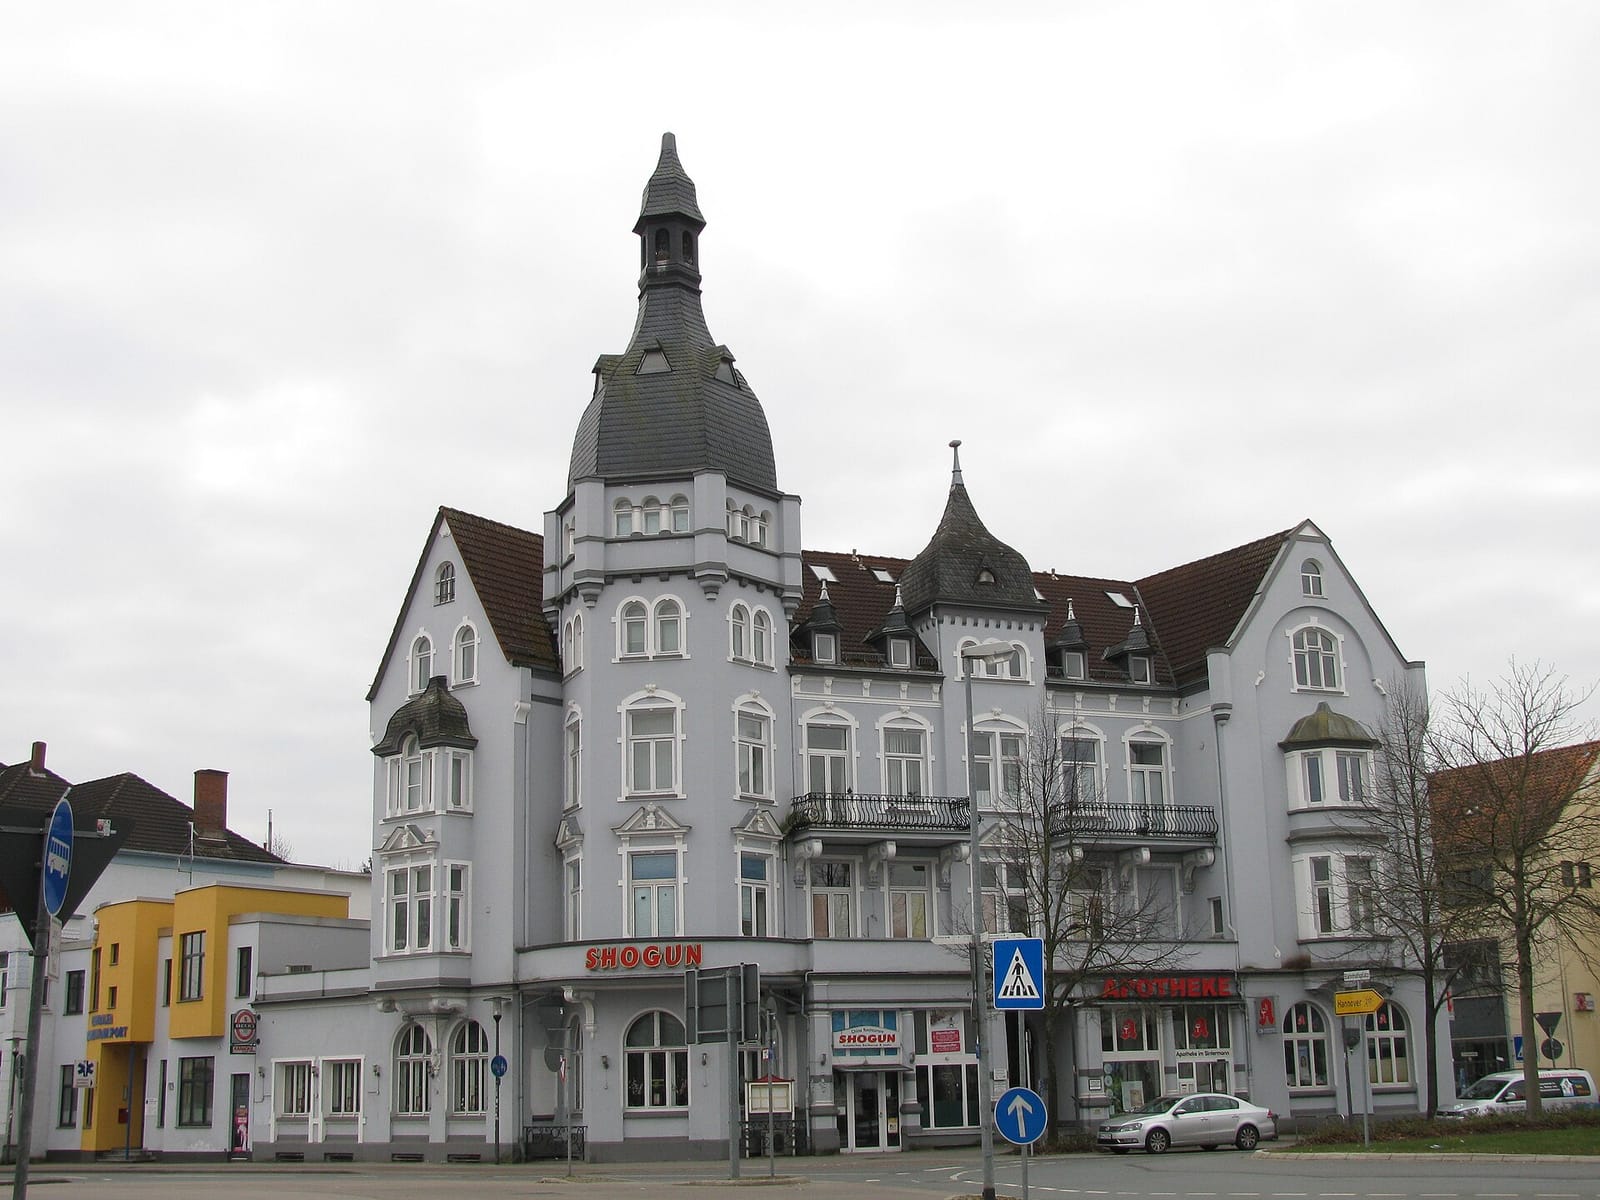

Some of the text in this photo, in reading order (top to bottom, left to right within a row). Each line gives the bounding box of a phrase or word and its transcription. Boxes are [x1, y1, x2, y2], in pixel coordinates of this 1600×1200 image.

[585, 944, 702, 970] SHOGUN
[1103, 977, 1232, 998] APOTHEKE
[839, 1034, 896, 1044] SHOGUN
[1176, 1050, 1198, 1058] Apotheke
